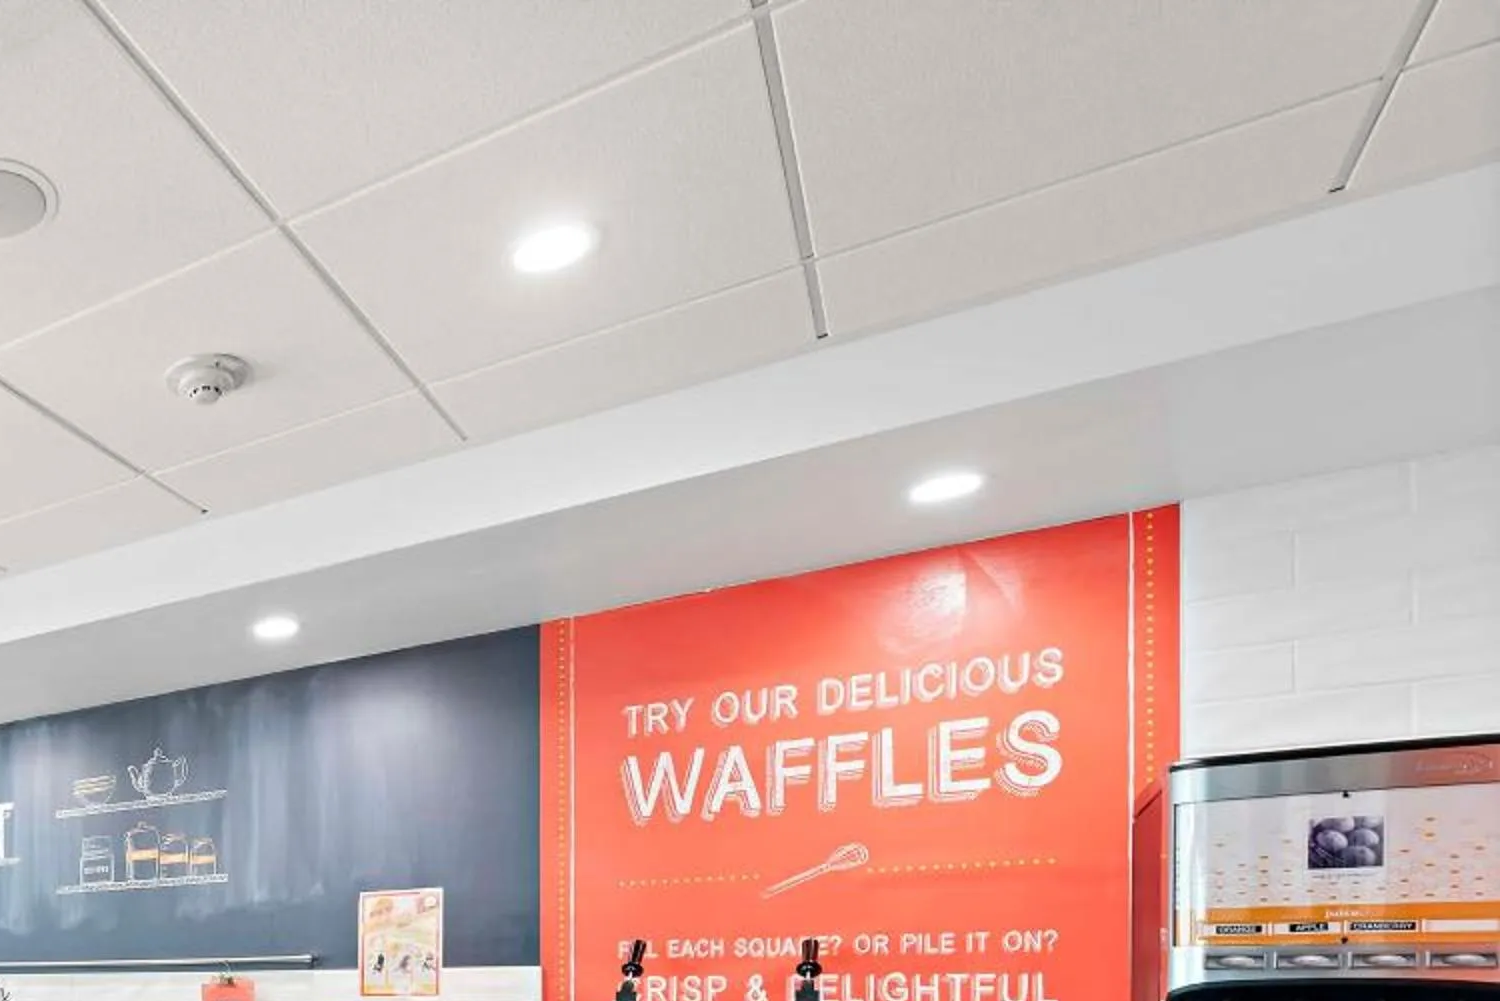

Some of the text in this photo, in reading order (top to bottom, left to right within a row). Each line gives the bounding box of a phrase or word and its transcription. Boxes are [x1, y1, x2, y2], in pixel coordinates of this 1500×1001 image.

[620, 647, 1064, 738] TRY OUR DELICIOUS
[619, 710, 1063, 826] WAFFLES
[617, 940, 660, 959] FL
[667, 938, 724, 958] EACH
[855, 933, 889, 956] OR
[901, 932, 956, 955] PILE
[966, 930, 990, 953] IT
[1003, 929, 1059, 953] ON?
